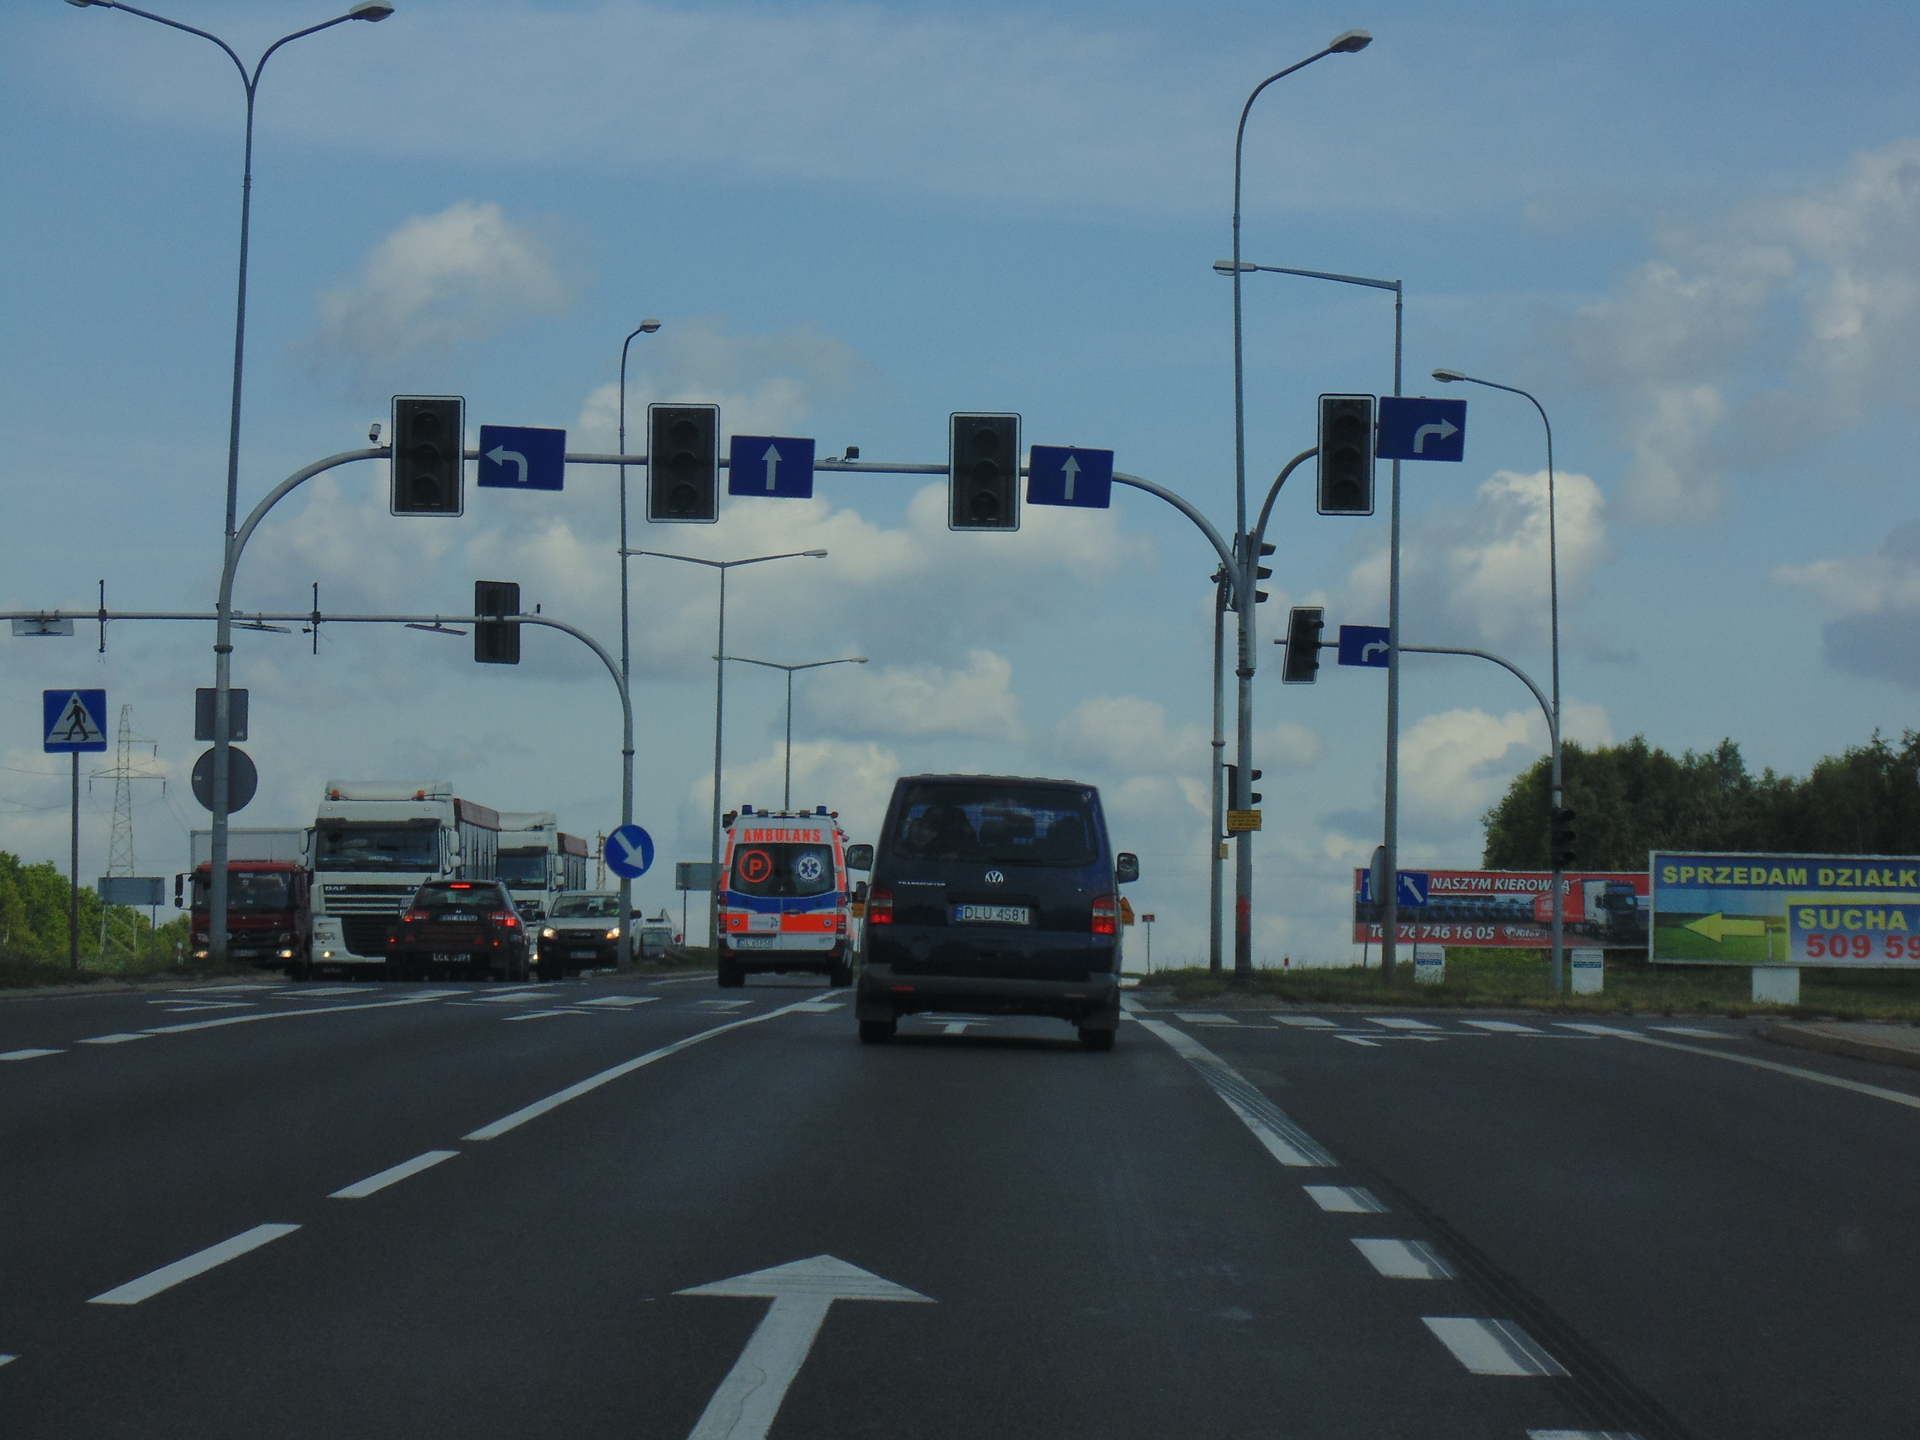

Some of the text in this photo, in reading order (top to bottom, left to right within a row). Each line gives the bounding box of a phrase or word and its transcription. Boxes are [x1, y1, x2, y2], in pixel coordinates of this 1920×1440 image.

[743, 828, 821, 843] AMBULANS
[749, 859, 764, 876] P
[1662, 866, 1920, 888] SPRZEDAM DZIAŁK
[1431, 877, 1571, 895] NASZYM KIEROWĄ
[964, 906, 1026, 922] DLU 4S81
[1798, 908, 1909, 931] SUCHA
[1422, 926, 1451, 939] 746
[1455, 926, 1473, 940] 16
[1476, 926, 1495, 940] 05
[1805, 934, 1872, 959] 509
